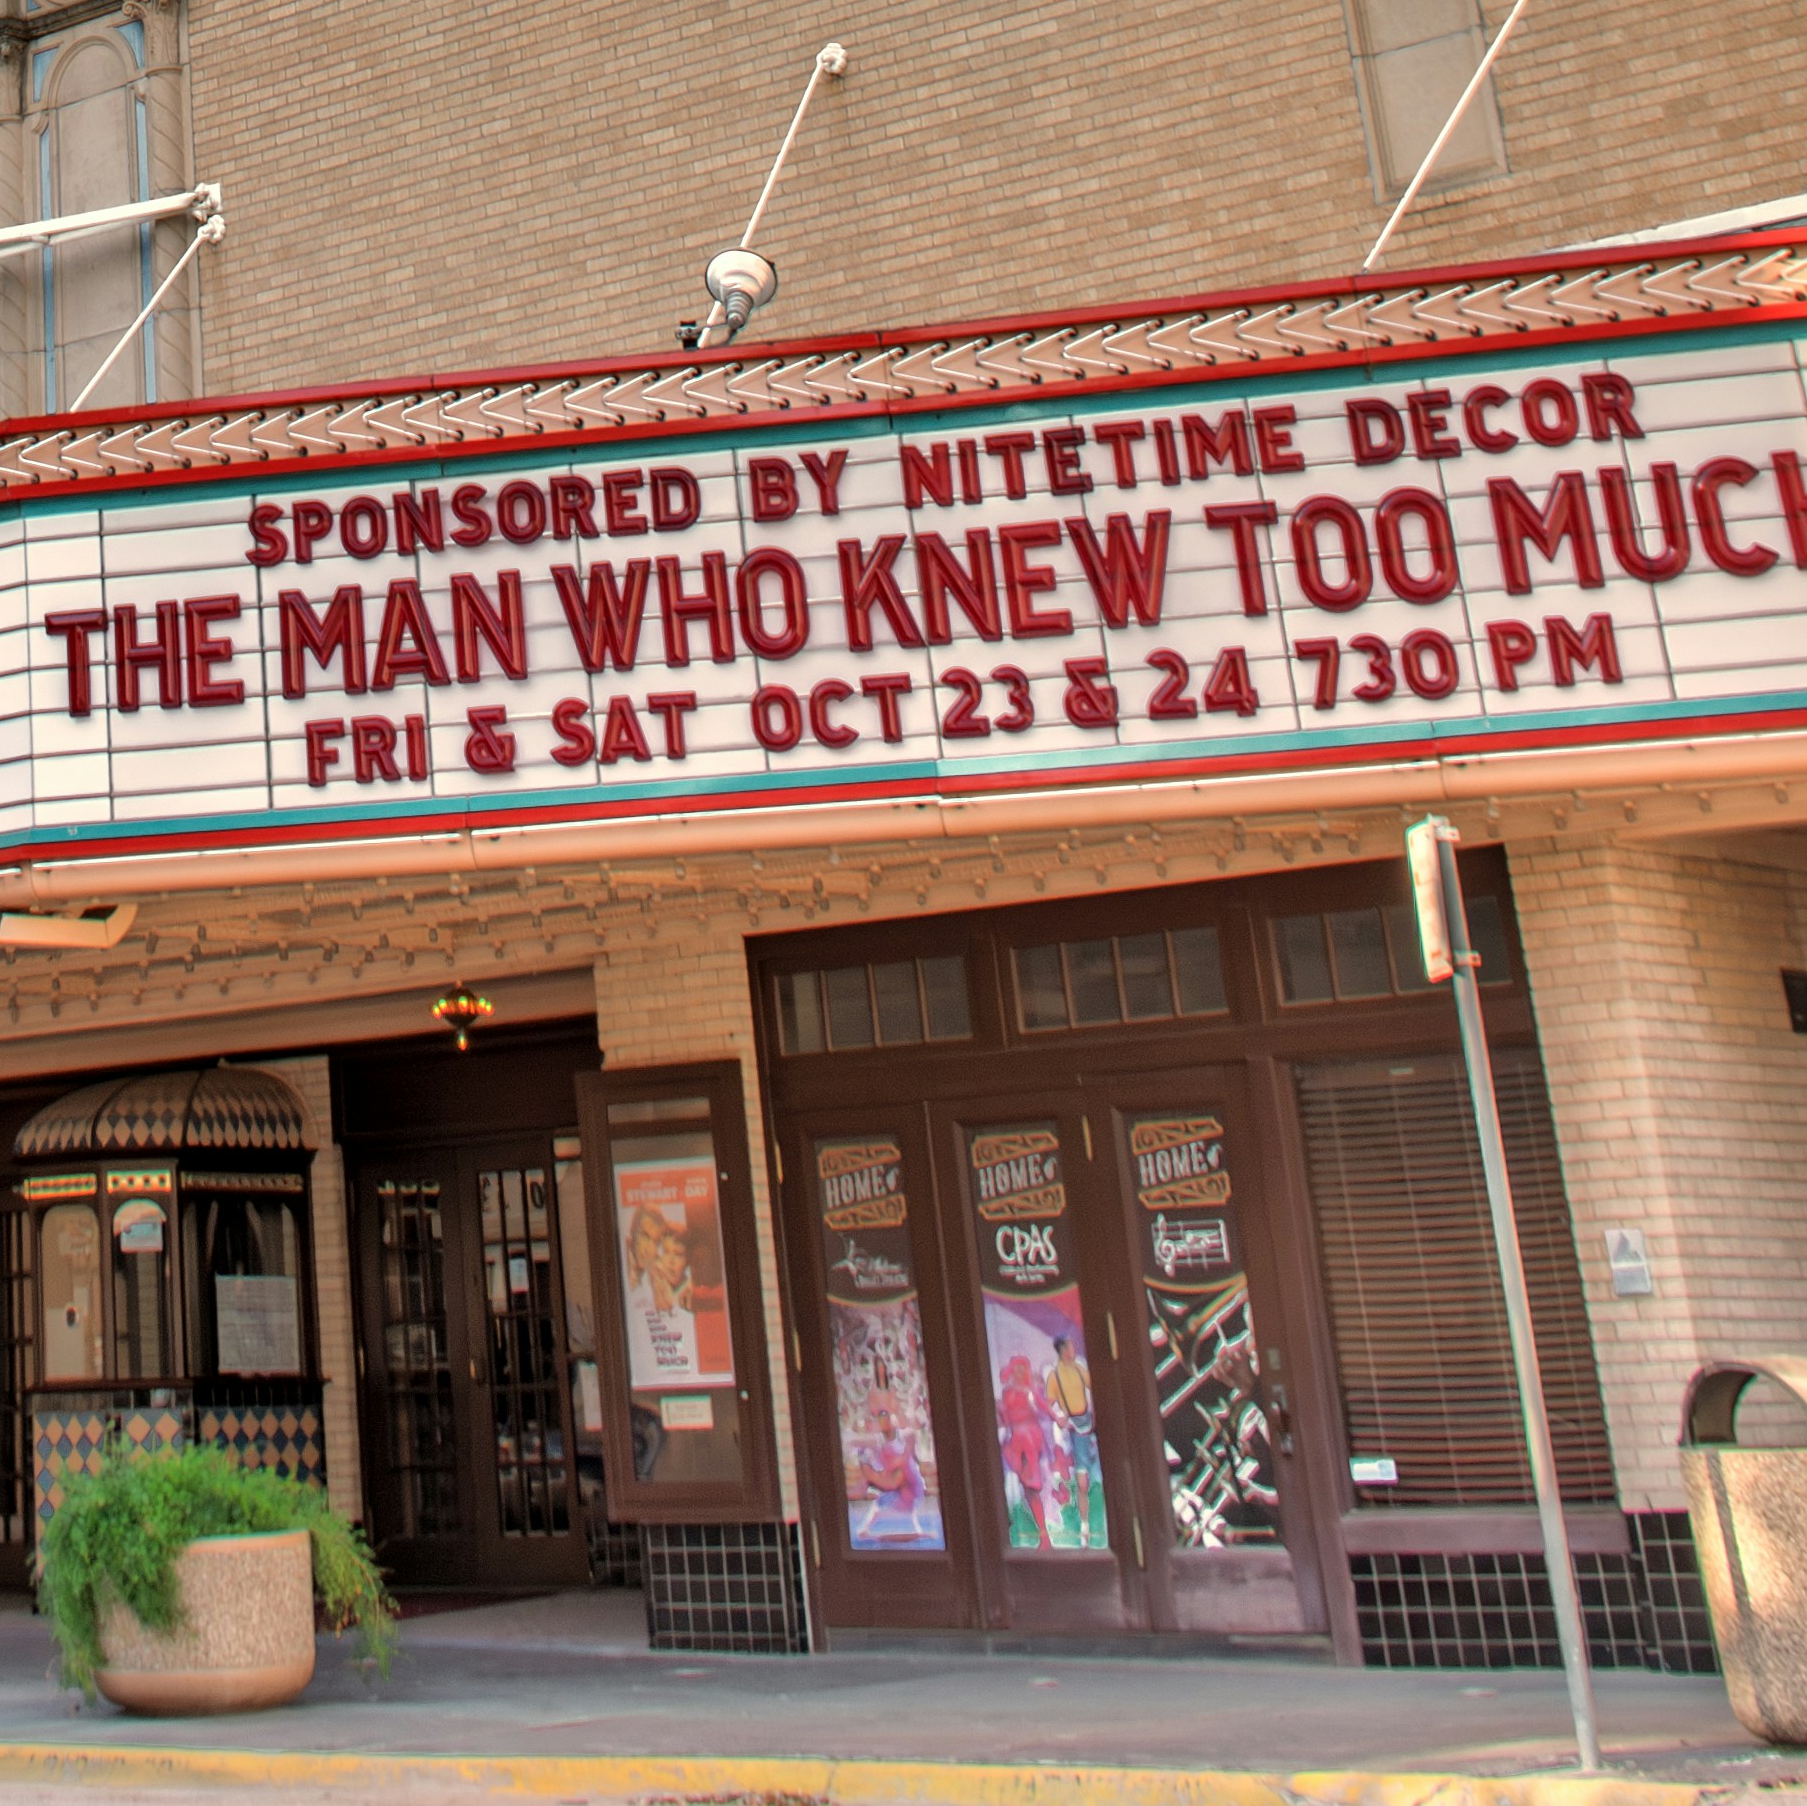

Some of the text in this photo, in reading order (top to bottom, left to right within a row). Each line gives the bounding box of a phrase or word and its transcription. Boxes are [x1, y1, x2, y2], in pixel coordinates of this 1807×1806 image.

[246, 373, 1645, 568] SPONSORED BY NITETIME DECOR
[44, 594, 245, 715] THE
[278, 569, 528, 699] MAN
[550, 546, 810, 673] WHO
[837, 509, 1173, 653] KNEW
[1203, 487, 1459, 616] TOO
[305, 613, 1622, 786] FRI & SAT OCT 23 & 24 730 PM
[825, 1164, 887, 1209] HOME
[979, 1153, 1044, 1200] HOME
[1139, 1139, 1209, 1188] HOME
[685, 1183, 708, 1198] DAY
[996, 1223, 1058, 1266] CPAS
